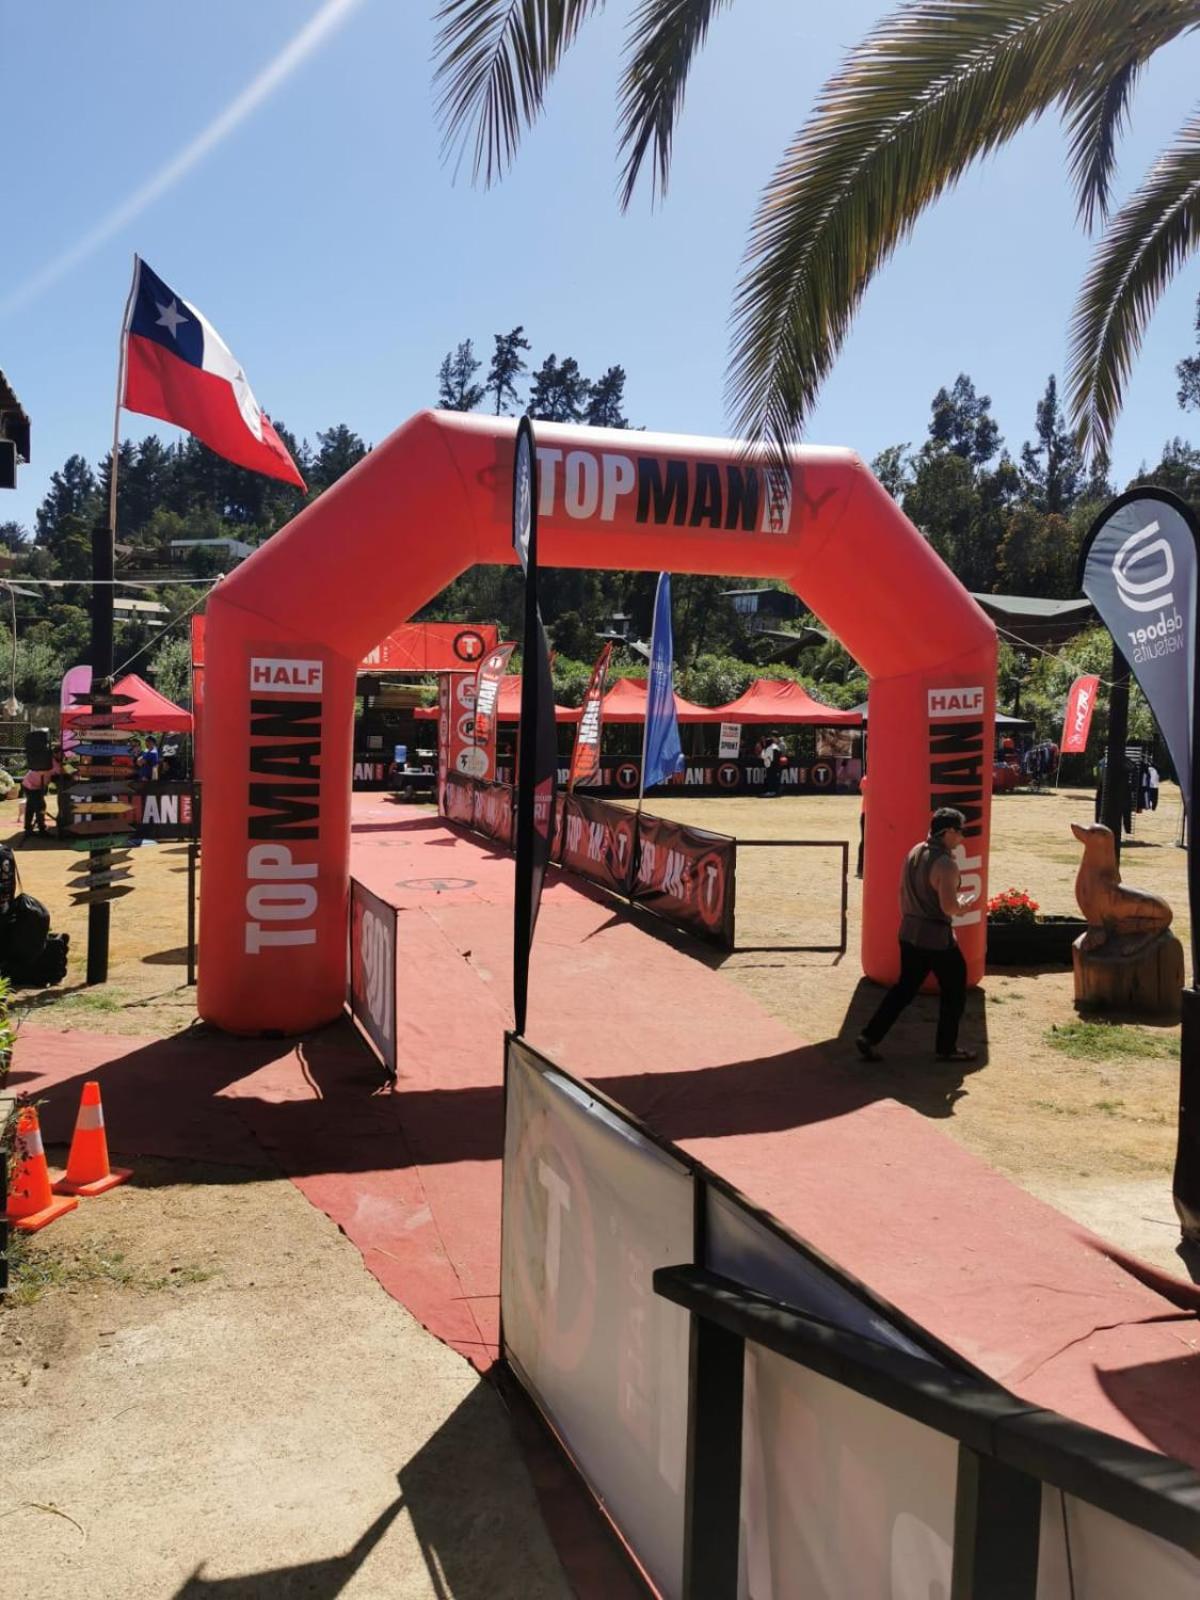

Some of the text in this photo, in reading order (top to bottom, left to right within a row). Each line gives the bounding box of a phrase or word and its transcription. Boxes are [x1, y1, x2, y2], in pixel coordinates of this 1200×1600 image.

[536, 447, 760, 532] TOPMAN
[253, 666, 321, 686] HALF
[930, 693, 982, 711] HALF
[746, 767, 799, 784] TOPAN
[245, 699, 323, 955] TOPMAN
